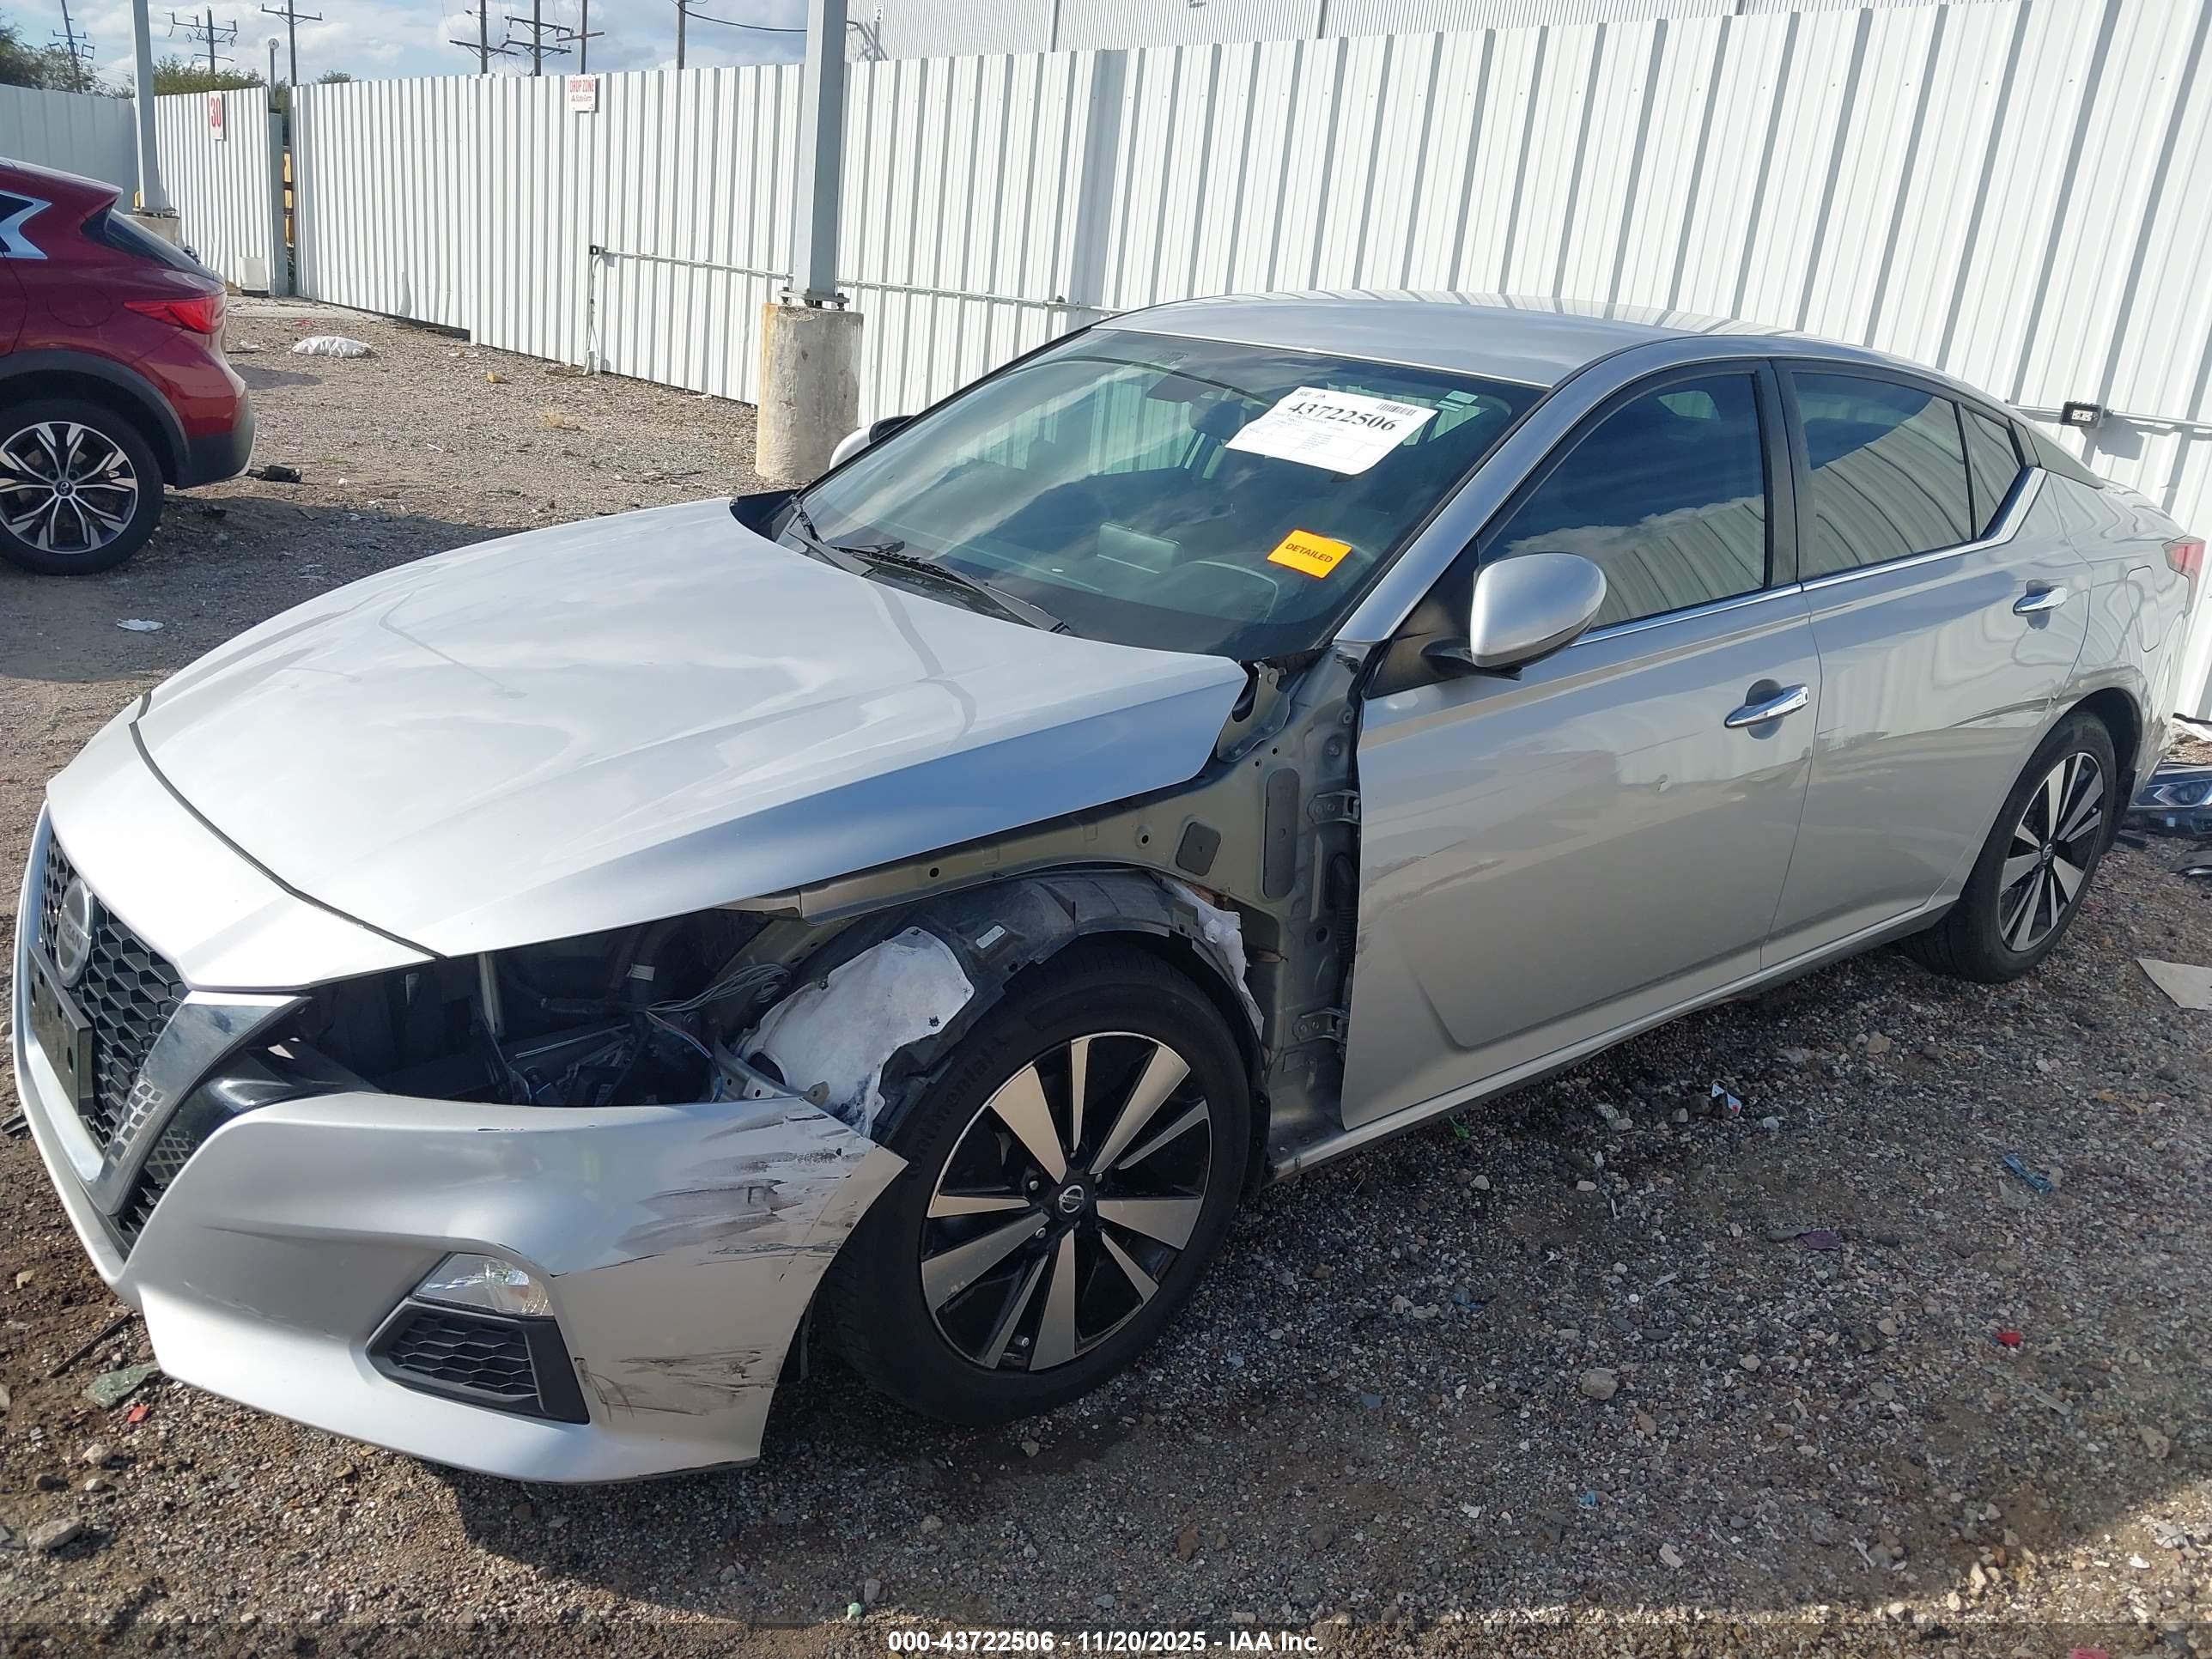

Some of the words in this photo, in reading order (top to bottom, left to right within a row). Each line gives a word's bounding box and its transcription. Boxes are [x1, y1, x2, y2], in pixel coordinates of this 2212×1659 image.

[570, 79, 581, 93] DROP
[582, 78, 594, 92] ZONE
[210, 97, 222, 128] 30
[1287, 401, 1402, 431] 43722506
[1285, 543, 1333, 562] DETAILED
